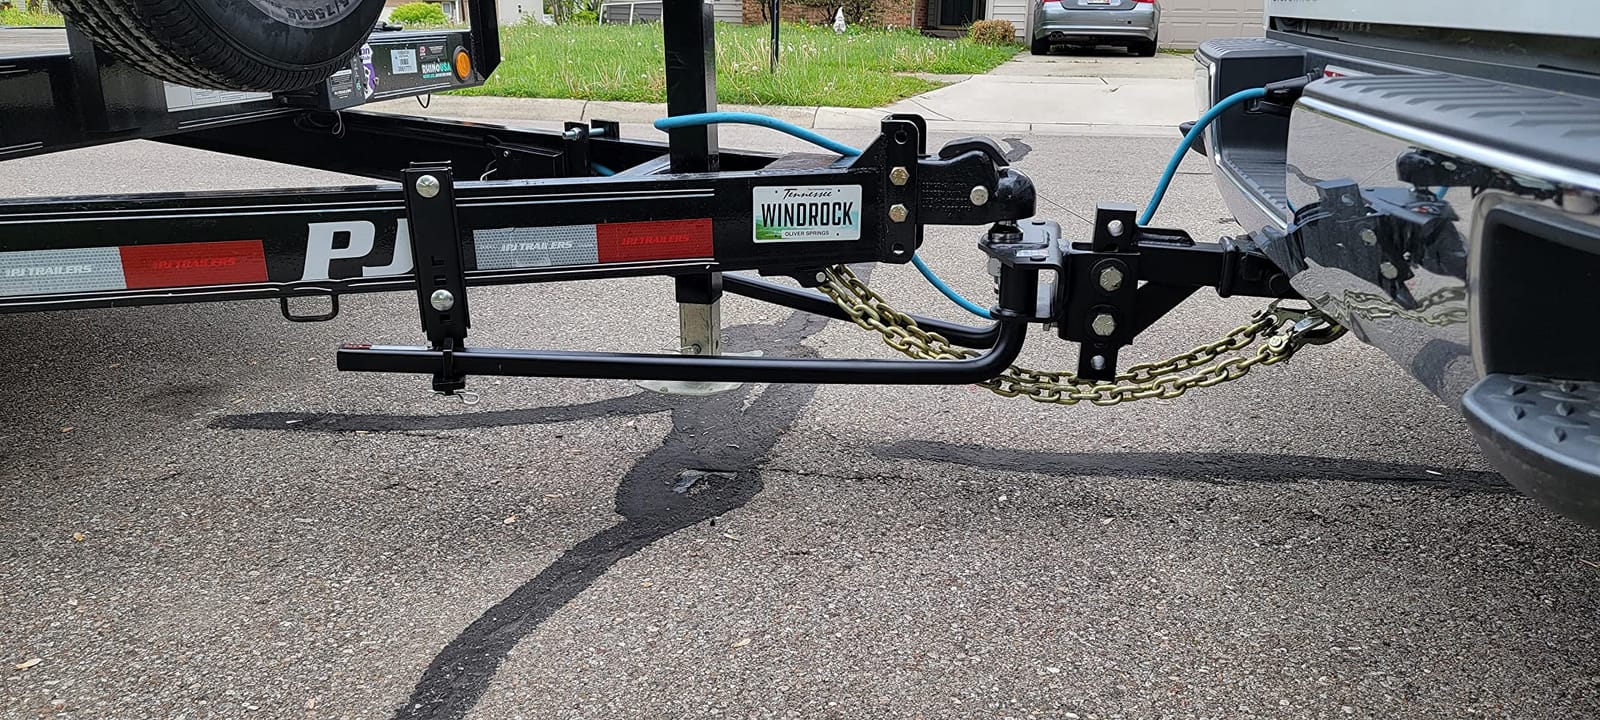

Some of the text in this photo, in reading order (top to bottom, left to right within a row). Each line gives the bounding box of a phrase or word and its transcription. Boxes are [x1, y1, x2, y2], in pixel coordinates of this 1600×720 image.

[783, 188, 833, 200] Tennessee
[761, 201, 853, 227] WINDROCK
[301, 218, 414, 281] PJ
